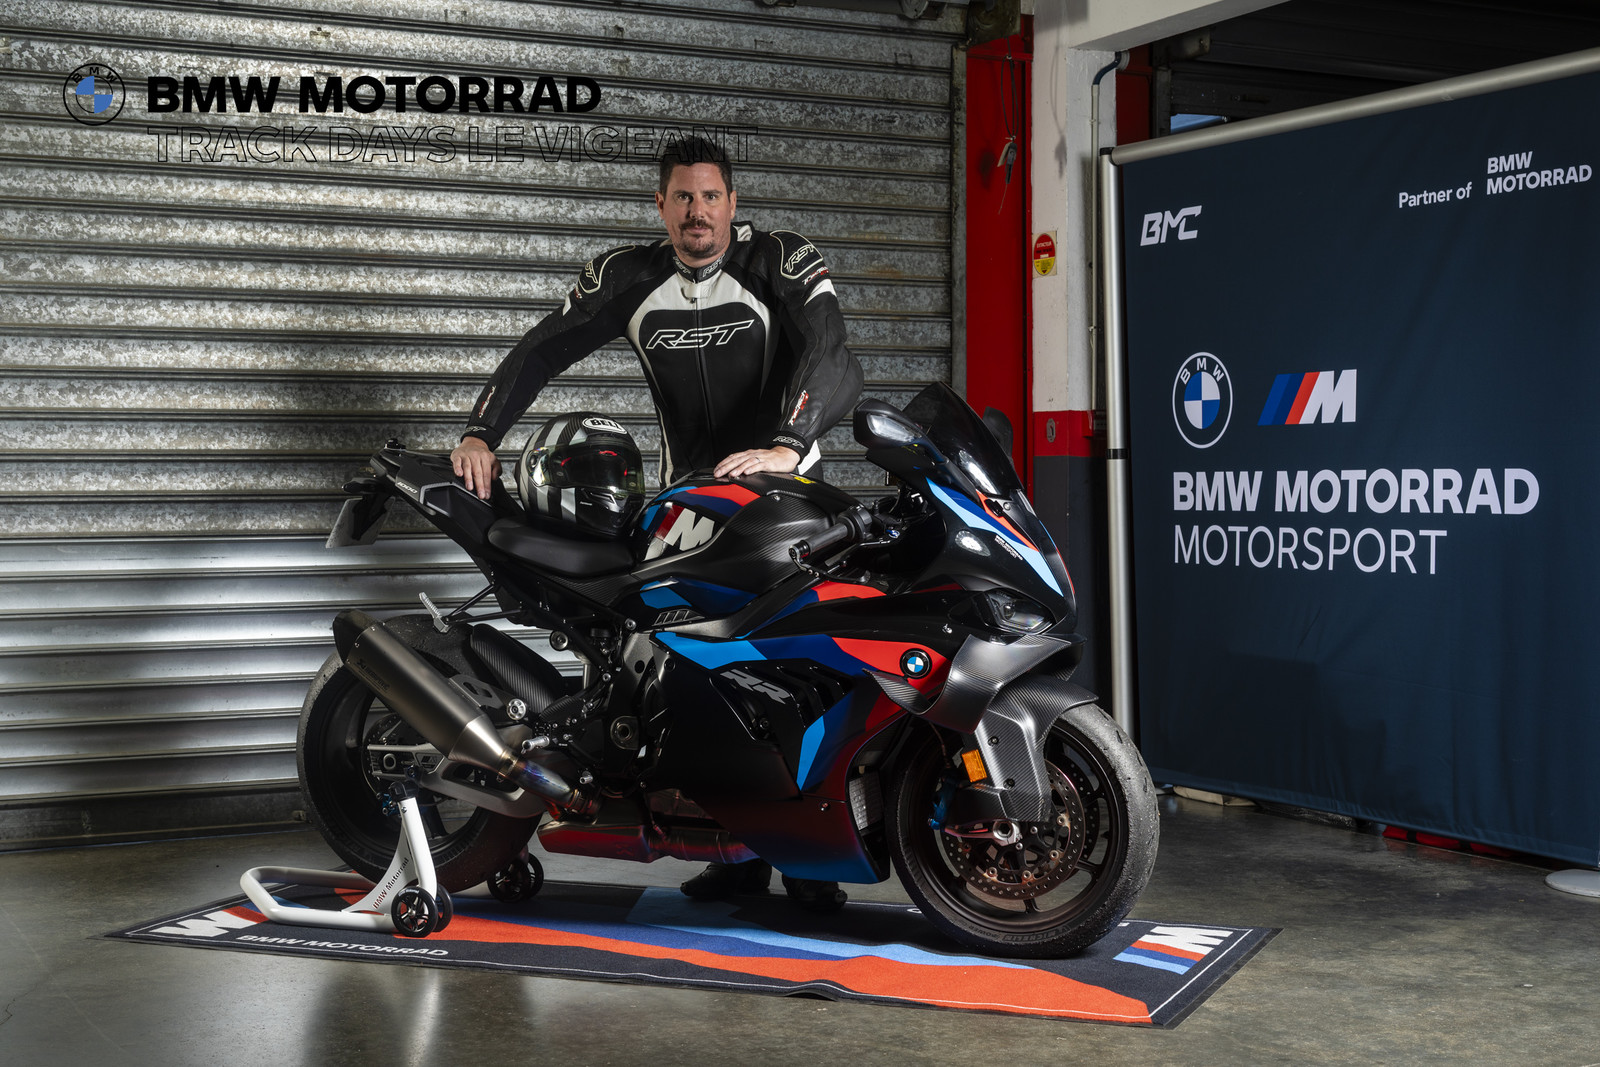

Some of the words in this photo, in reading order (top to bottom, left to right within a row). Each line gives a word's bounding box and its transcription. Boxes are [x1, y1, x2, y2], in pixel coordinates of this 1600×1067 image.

[1487, 151, 1533, 175] BMW
[1398, 188, 1453, 209] Partner
[1456, 181, 1473, 200] of
[1486, 164, 1593, 195] MOTORRAD
[1140, 205, 1202, 246] BMC
[784, 244, 815, 274] RST
[646, 319, 755, 350] RST
[1180, 357, 1225, 384] BMW
[773, 435, 804, 448] RST
[1173, 471, 1262, 513] BMW
[1274, 468, 1540, 516] MOTORRAD
[663, 507, 715, 552] M
[1174, 524, 1448, 575] MOTORSPORT
[720, 668, 791, 705] RR
[385, 857, 409, 891] Motorrad
[236, 934, 305, 946] BMW
[302, 940, 449, 957] MOTORRAD
